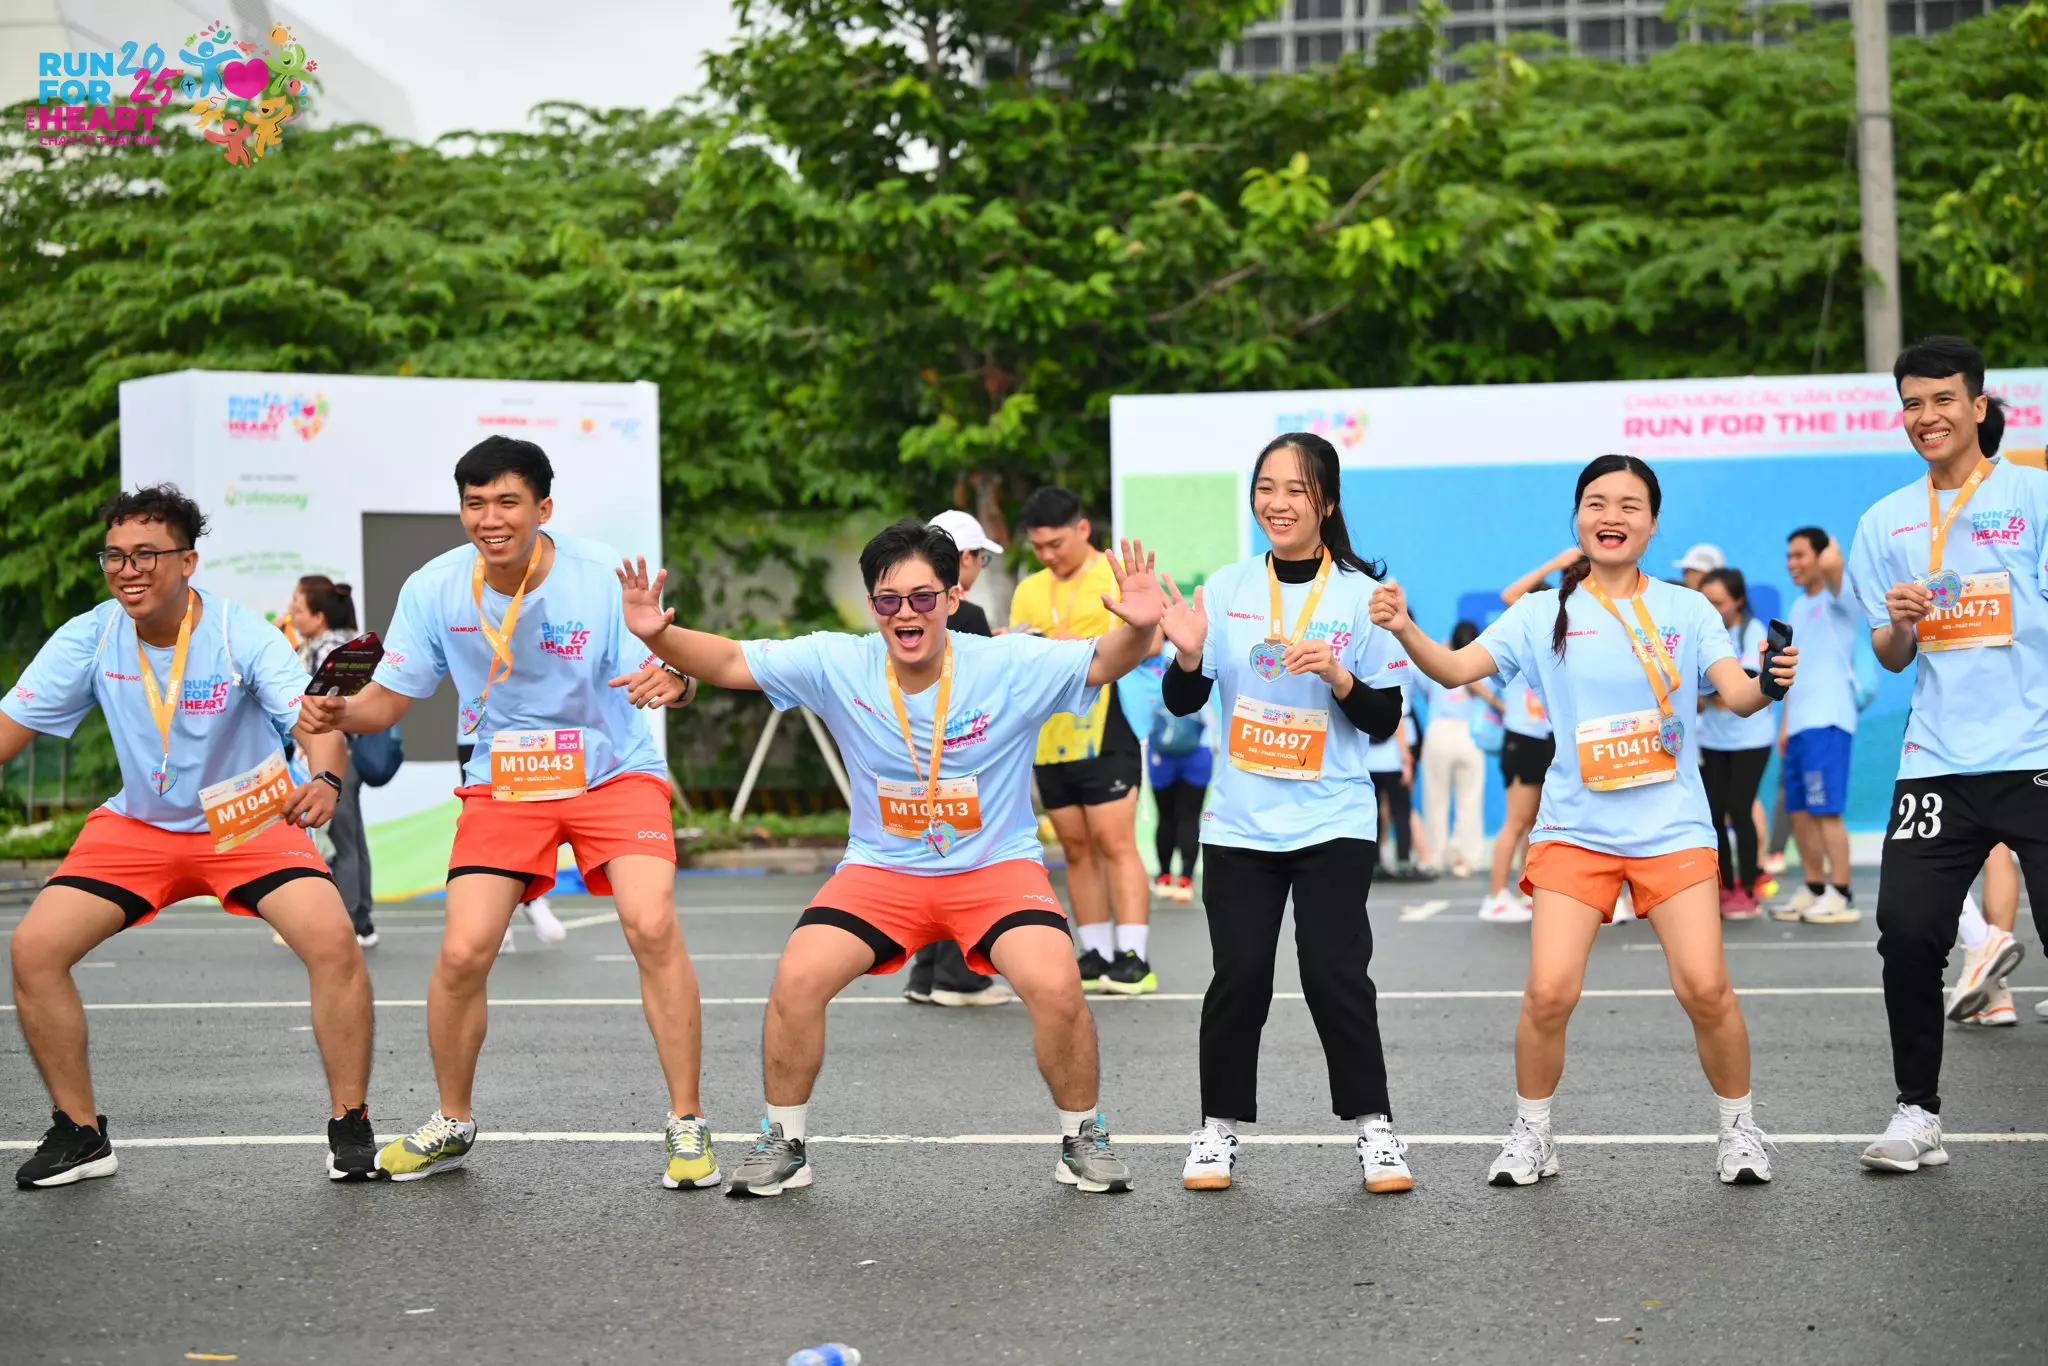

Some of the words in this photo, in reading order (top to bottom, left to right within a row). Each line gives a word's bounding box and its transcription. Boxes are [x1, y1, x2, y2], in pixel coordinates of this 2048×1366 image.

[1624, 417, 1693, 438] RUN
[1701, 413, 1767, 435] FOR
[1773, 411, 1838, 434] THE
[1844, 409, 1904, 432] HEA
[2004, 405, 2043, 427] 25
[1972, 510, 2002, 521] RUN
[1972, 520, 2000, 531] FOR
[1977, 529, 2020, 541] HEART
[1308, 621, 1329, 633] UN
[1330, 620, 1349, 634] 20
[571, 630, 591, 645] 25
[1331, 631, 1352, 647] 25
[1665, 633, 1681, 646] 25
[545, 640, 583, 655] HART
[184, 679, 212, 690] RUN
[212, 681, 229, 698] 25
[184, 689, 210, 700] FOR
[184, 698, 224, 710] HEART
[972, 714, 990, 732] 25
[1241, 723, 1313, 751] F10497
[1592, 735, 1661, 762] F10416
[500, 754, 574, 773] M10443
[216, 778, 288, 824] M10419
[889, 801, 969, 817] M10413
[1891, 793, 1943, 840] 23
